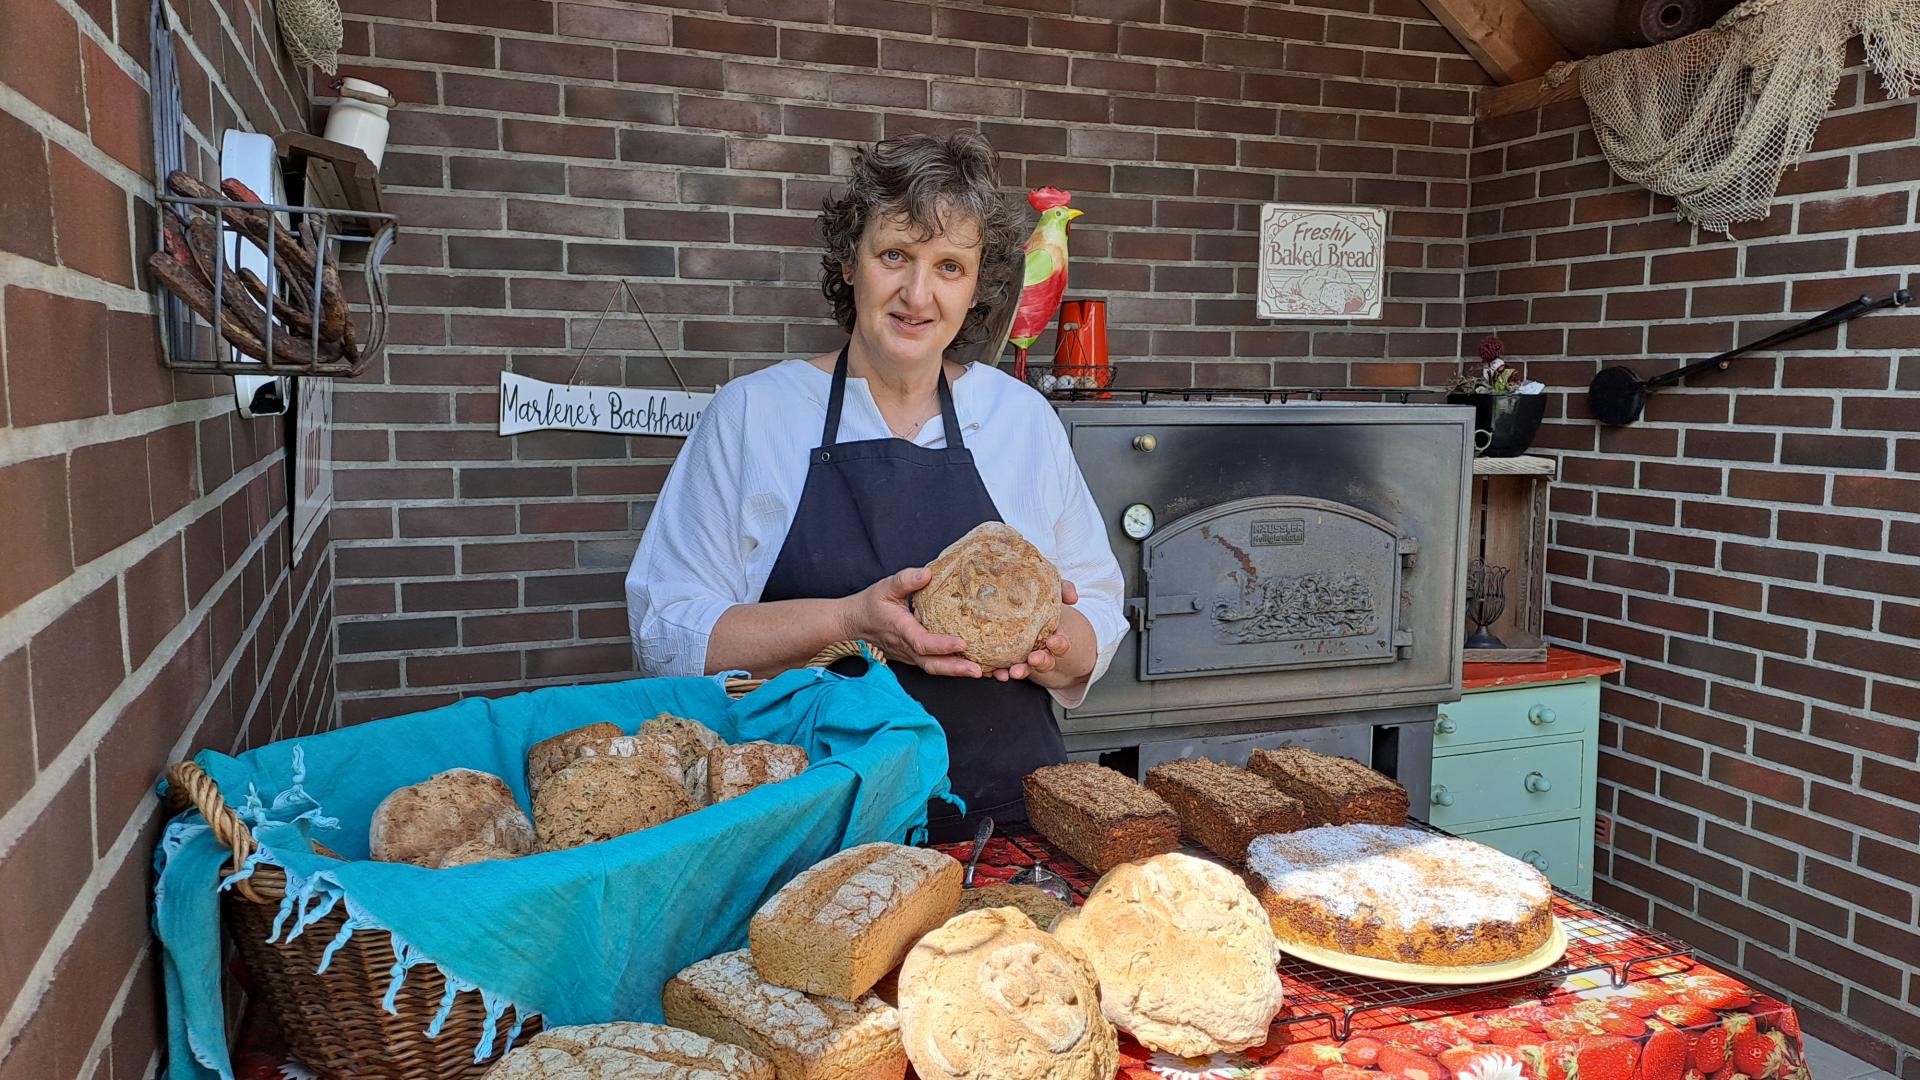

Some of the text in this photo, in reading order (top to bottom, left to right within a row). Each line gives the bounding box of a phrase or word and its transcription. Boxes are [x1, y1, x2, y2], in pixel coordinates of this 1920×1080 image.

[1292, 221, 1357, 248] Freshly
[1269, 241, 1377, 268] Baked Bread
[502, 382, 601, 428] Marlene's
